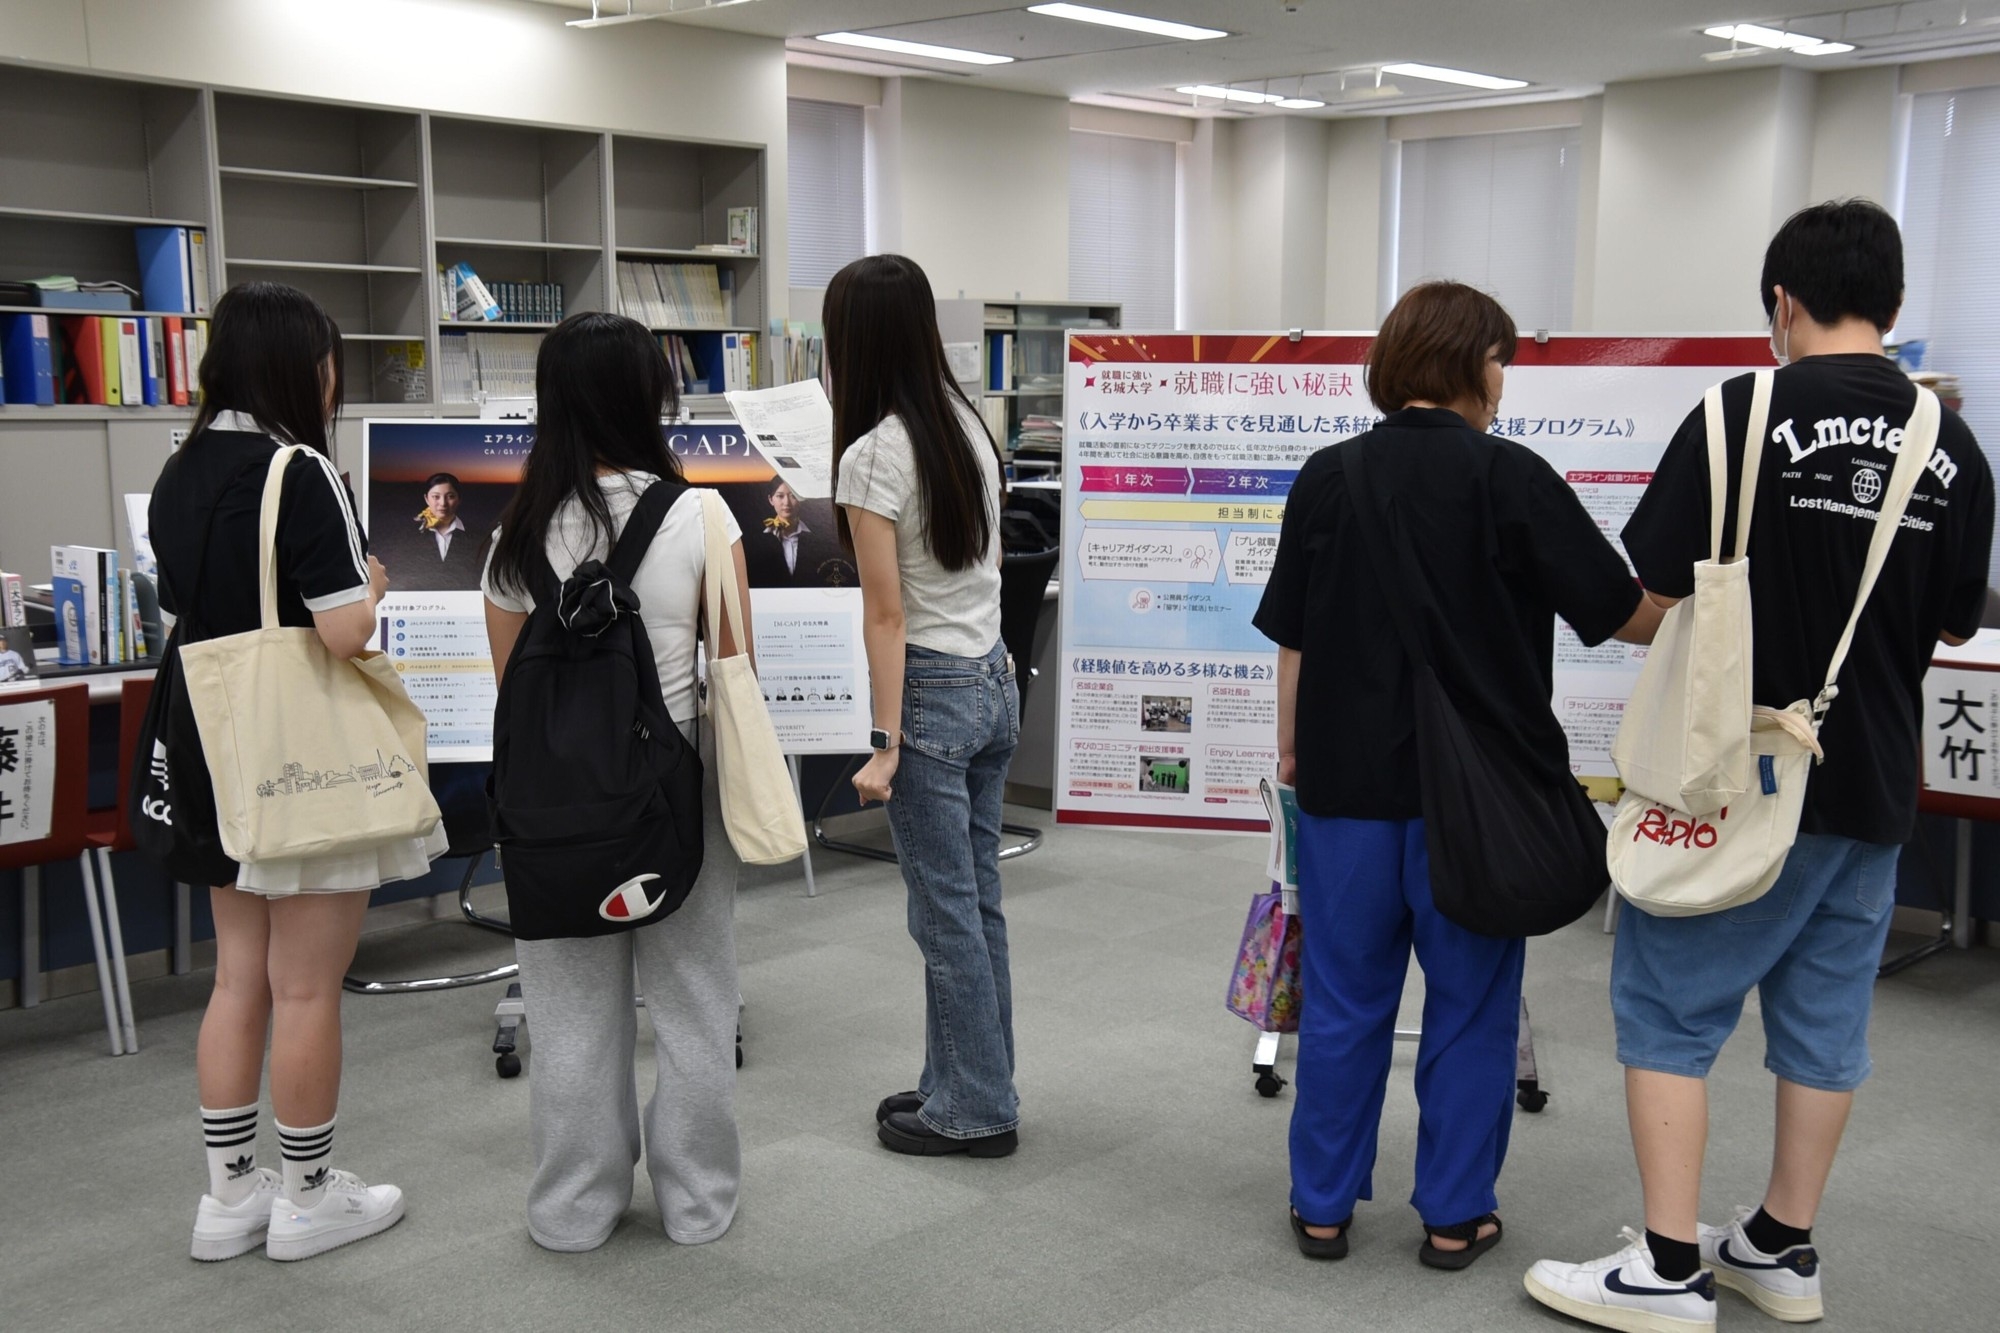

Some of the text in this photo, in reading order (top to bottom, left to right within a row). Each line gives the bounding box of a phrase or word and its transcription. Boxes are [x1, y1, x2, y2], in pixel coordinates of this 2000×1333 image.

[1101, 369, 1153, 380] 就職に強い
[1100, 381, 1153, 395] 名城大学
[1174, 370, 1353, 397] 就職に強い秘訣
[1078, 411, 1385, 435] 《入学から卒業までを見通した系統
[484, 433, 535, 444] エアライン
[1772, 415, 1958, 490] Lmctem
[1851, 457, 1888, 471] LANDMARK
[1114, 473, 1154, 487] 1年次
[1227, 475, 1269, 489] 2年次
[1782, 471, 1802, 479] PATH
[1072, 657, 1274, 681] 《経験値を高める多様な機会》
[1938, 689, 1987, 782] 大竹
[1209, 748, 1275, 760] Enjoy Learning
[1633, 808, 1717, 849] RADIO
